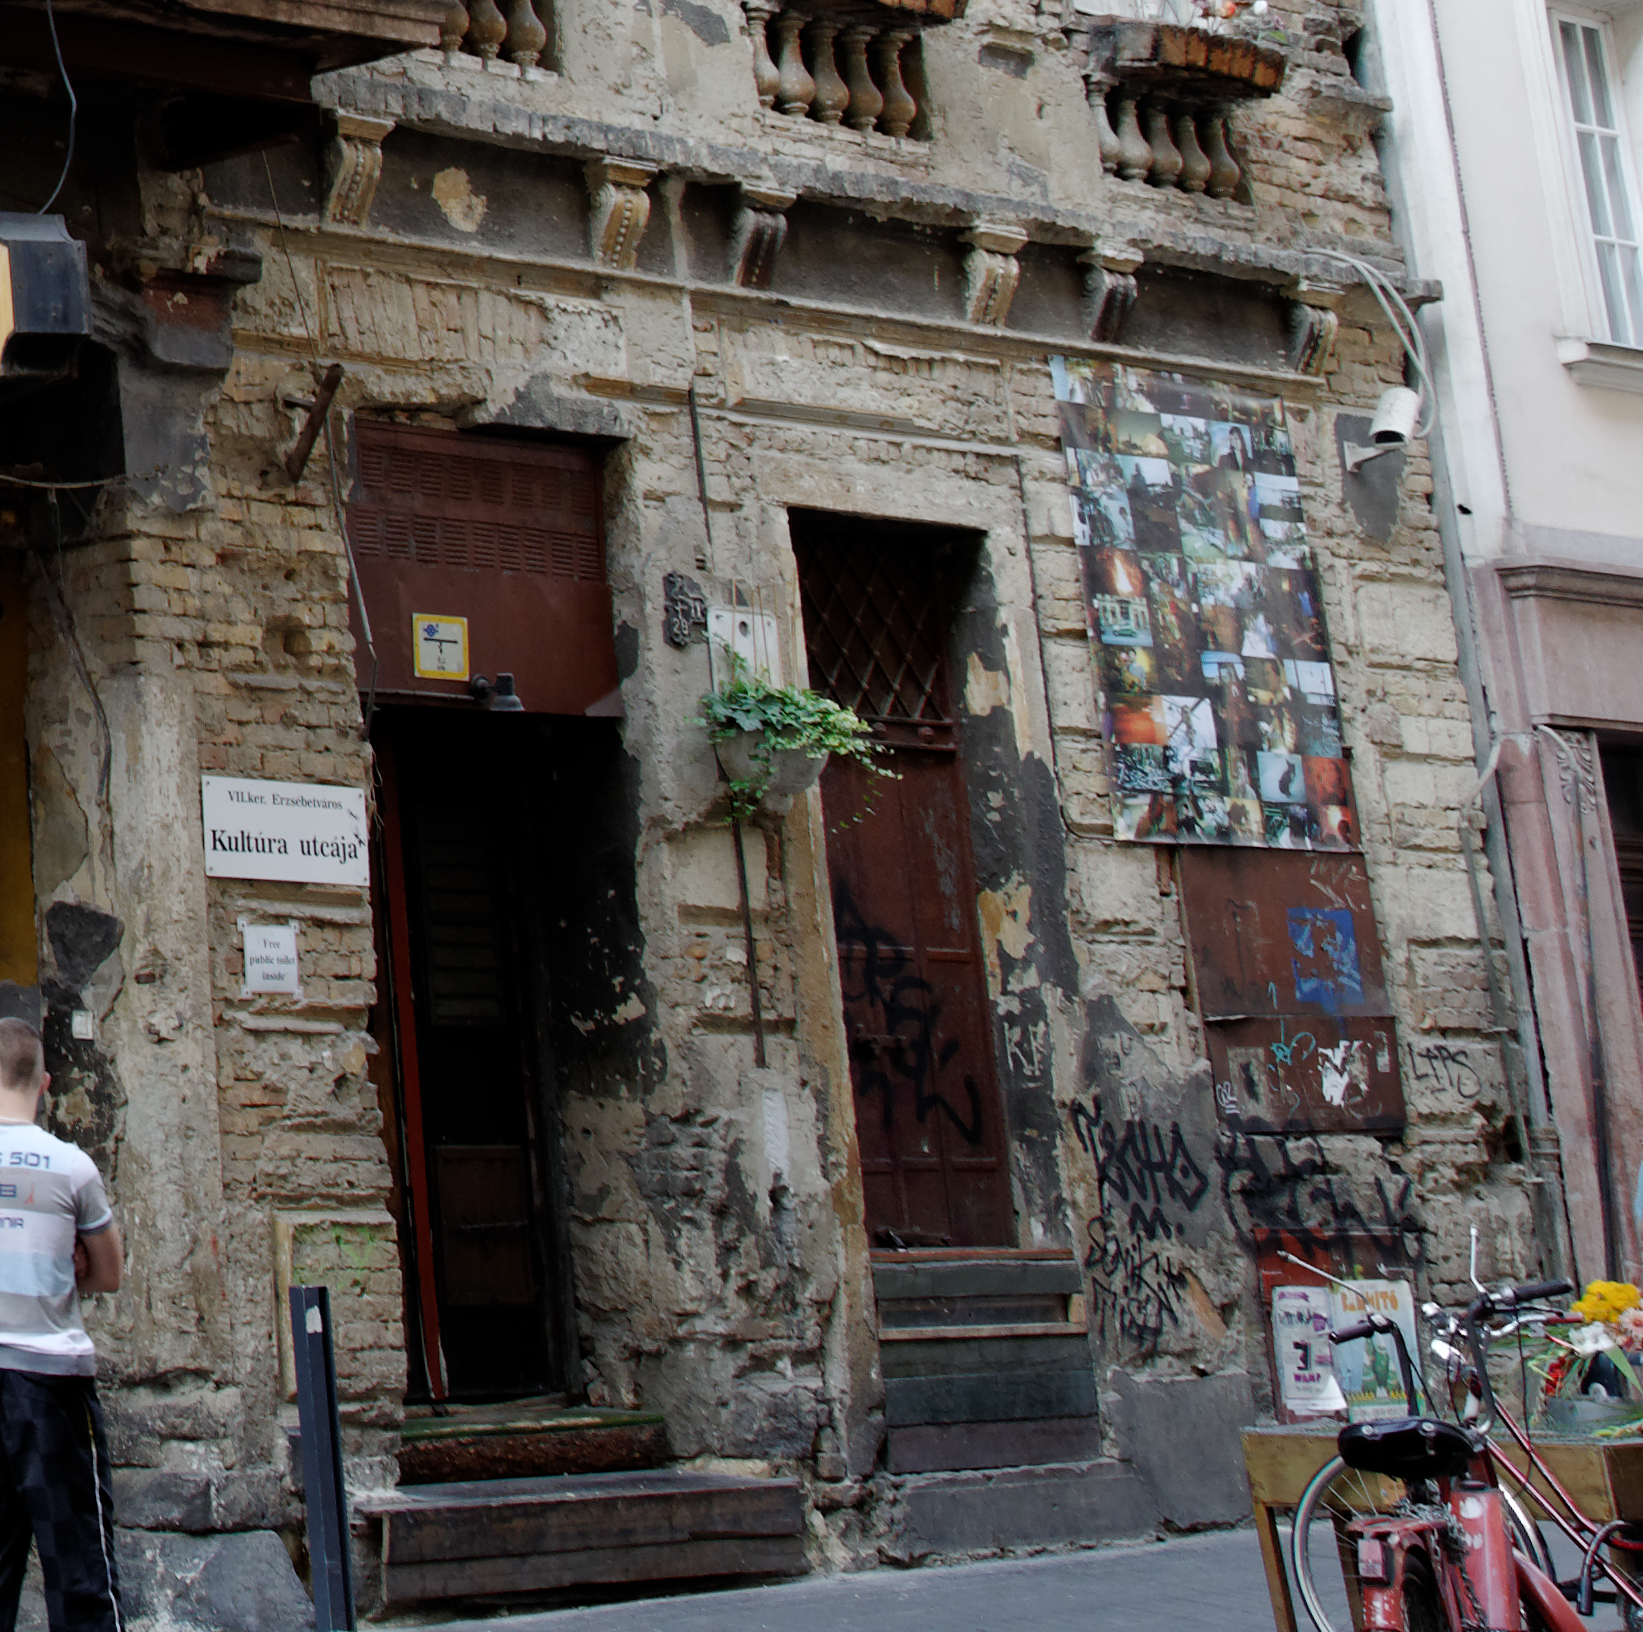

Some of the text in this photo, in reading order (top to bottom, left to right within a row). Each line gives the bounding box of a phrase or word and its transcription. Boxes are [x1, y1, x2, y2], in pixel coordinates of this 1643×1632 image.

[272, 793, 343, 810] Erzsébetváros
[211, 829, 358, 864] Kultúra utcája
[263, 939, 281, 948] Free
[249, 955, 275, 967] public
[9, 1151, 50, 1169] 501
